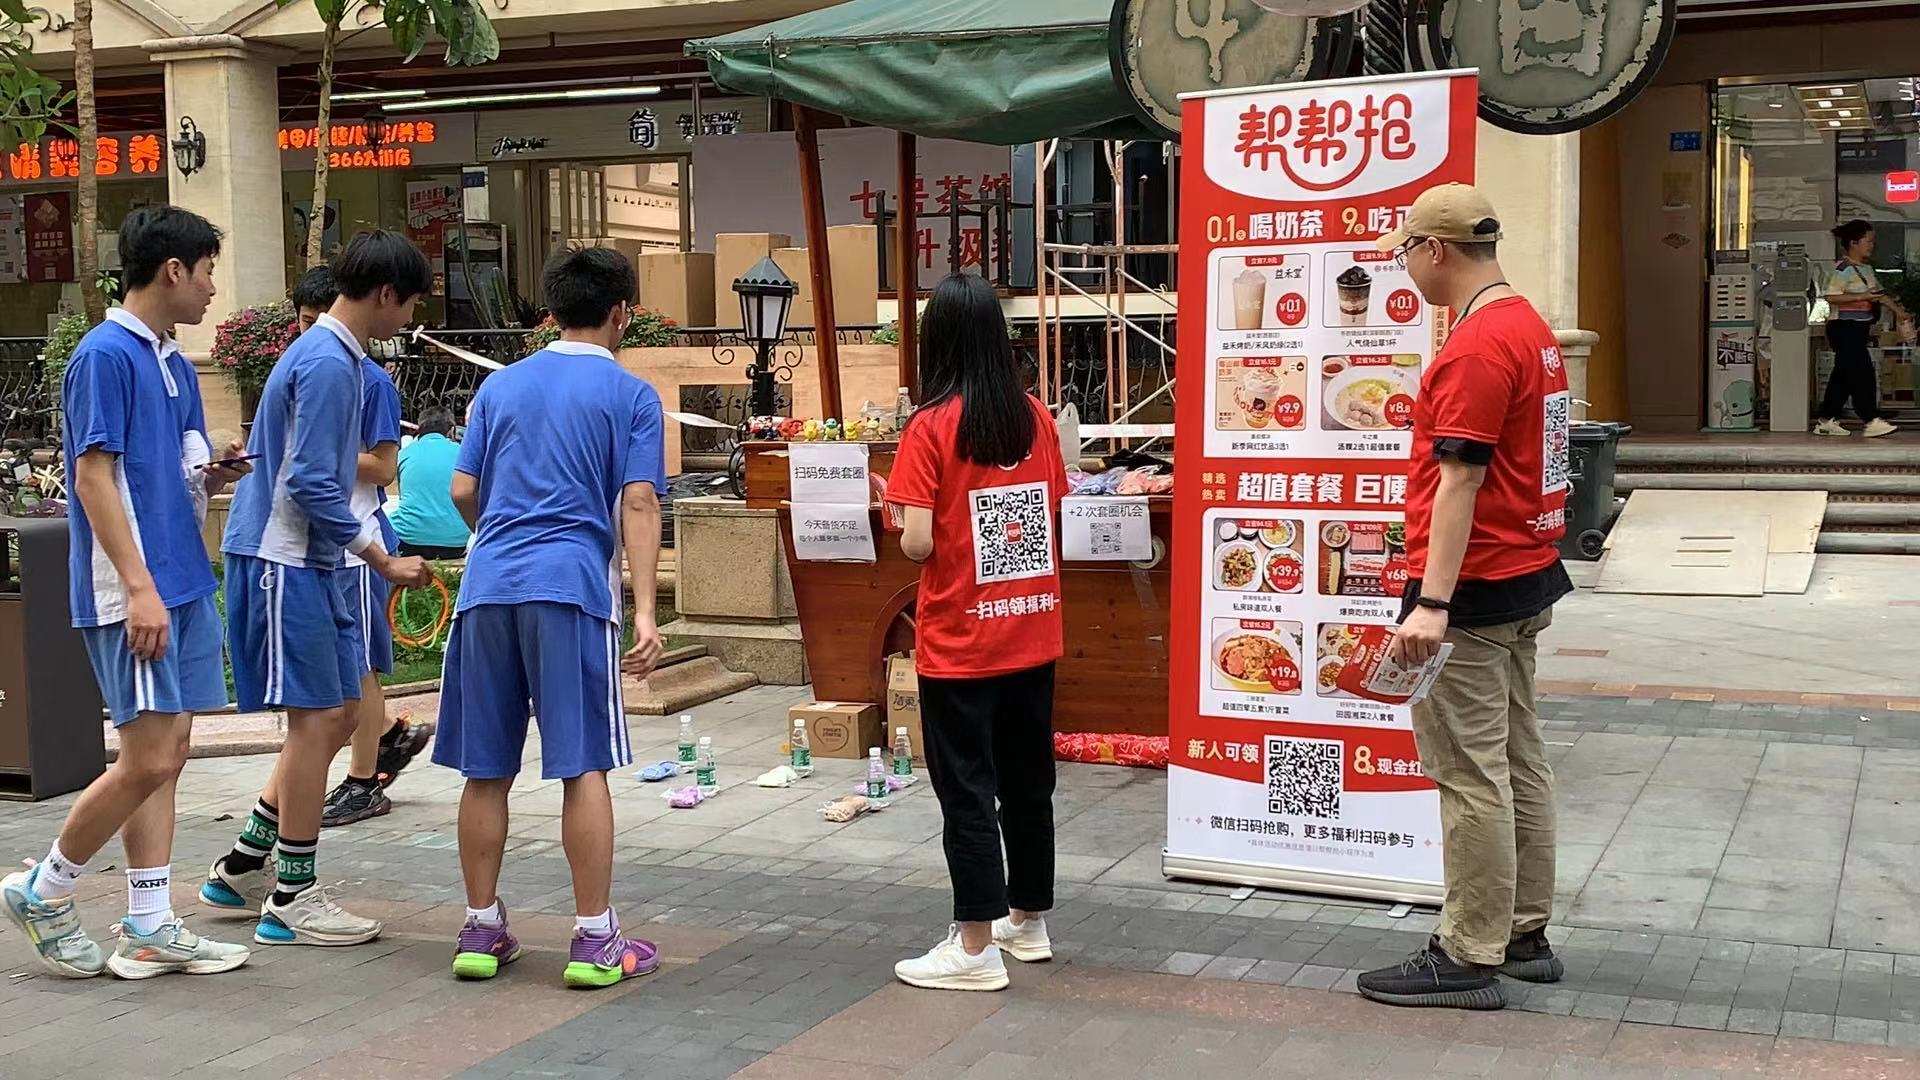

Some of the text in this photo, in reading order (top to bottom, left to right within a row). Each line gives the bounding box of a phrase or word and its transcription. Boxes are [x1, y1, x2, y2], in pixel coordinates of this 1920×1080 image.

[1234, 93, 1416, 192] 帮帮抢
[794, 466, 865, 480] 扫码免费套圈
[1202, 471, 1227, 485] 精选
[1202, 488, 1227, 501] 热卖
[1237, 471, 1344, 504] 超值套餐
[1085, 504, 1144, 519] 次套圈机会
[1187, 738, 1261, 764] 新人可领
[244, 818, 277, 843] DISS
[278, 856, 313, 876] DISS
[130, 877, 169, 889] VANS
